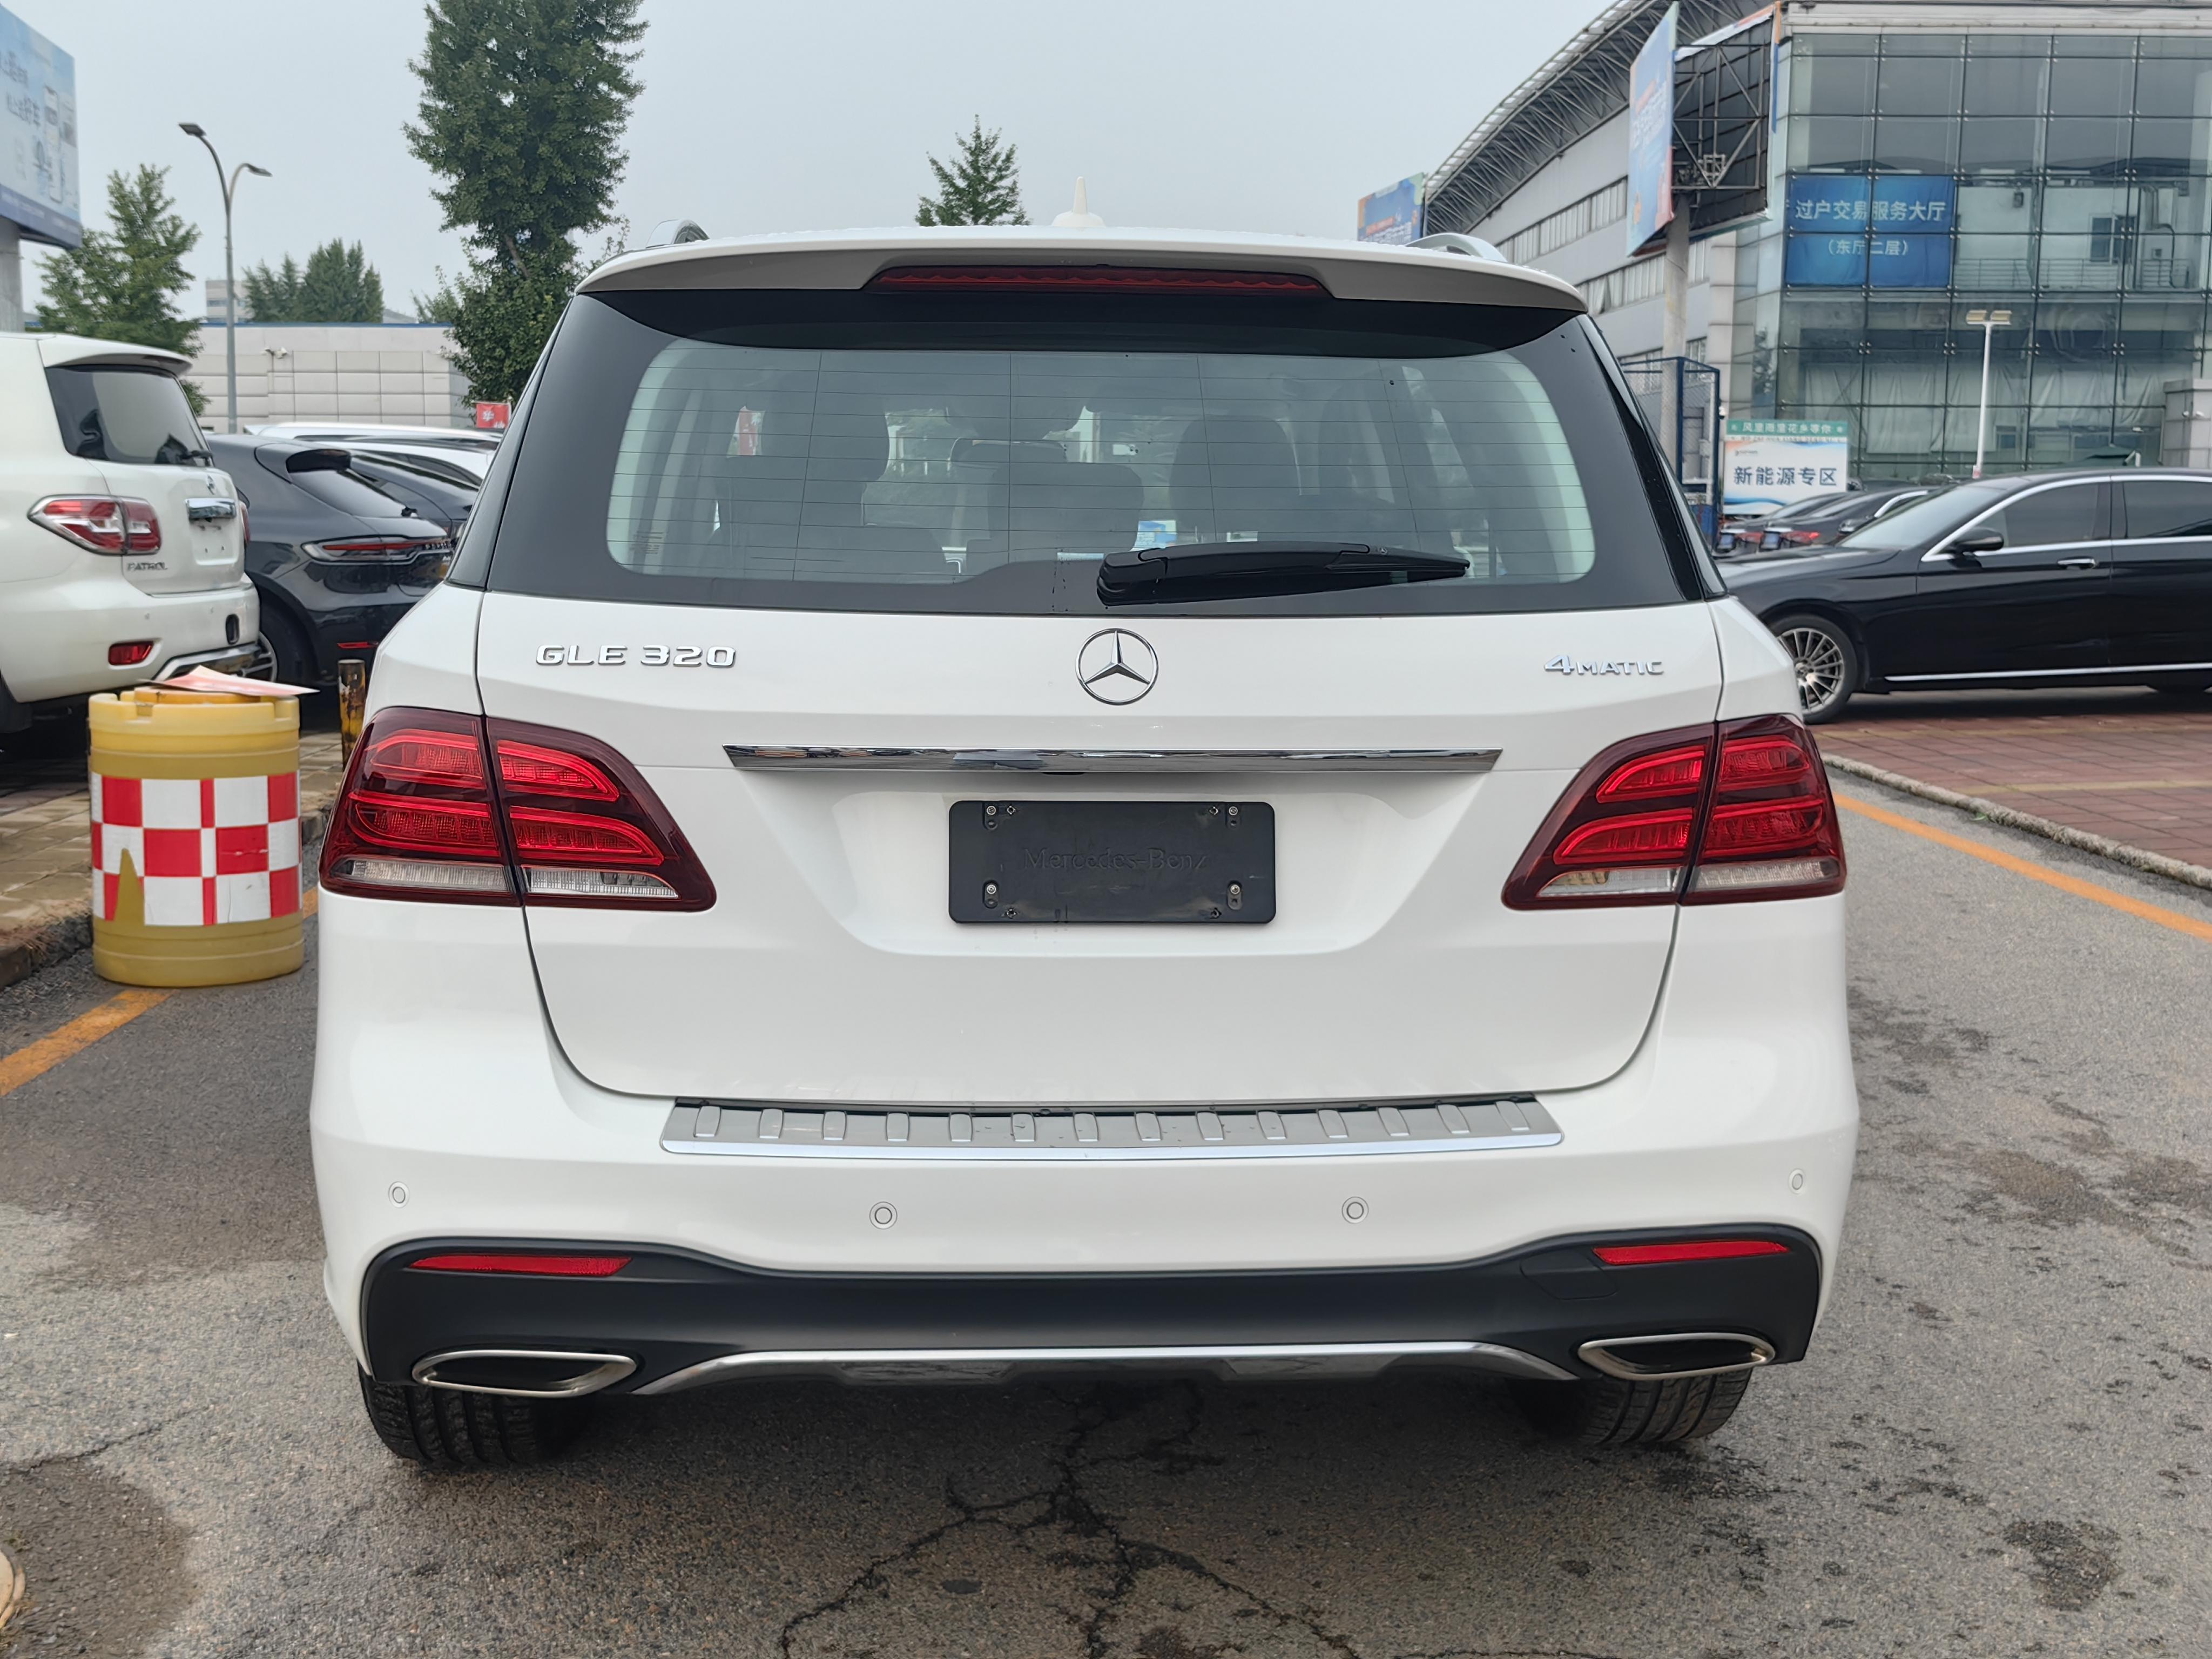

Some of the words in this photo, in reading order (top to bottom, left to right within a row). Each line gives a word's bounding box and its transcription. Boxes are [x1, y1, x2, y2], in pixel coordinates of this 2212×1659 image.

[1795, 200, 1946, 221] 过户交易服务大厅
[1734, 466, 1837, 486] 新能源专区
[536, 645, 628, 666] GLE
[640, 645, 736, 667] 320
[1023, 847, 1208, 870] Mercedes-Benz
